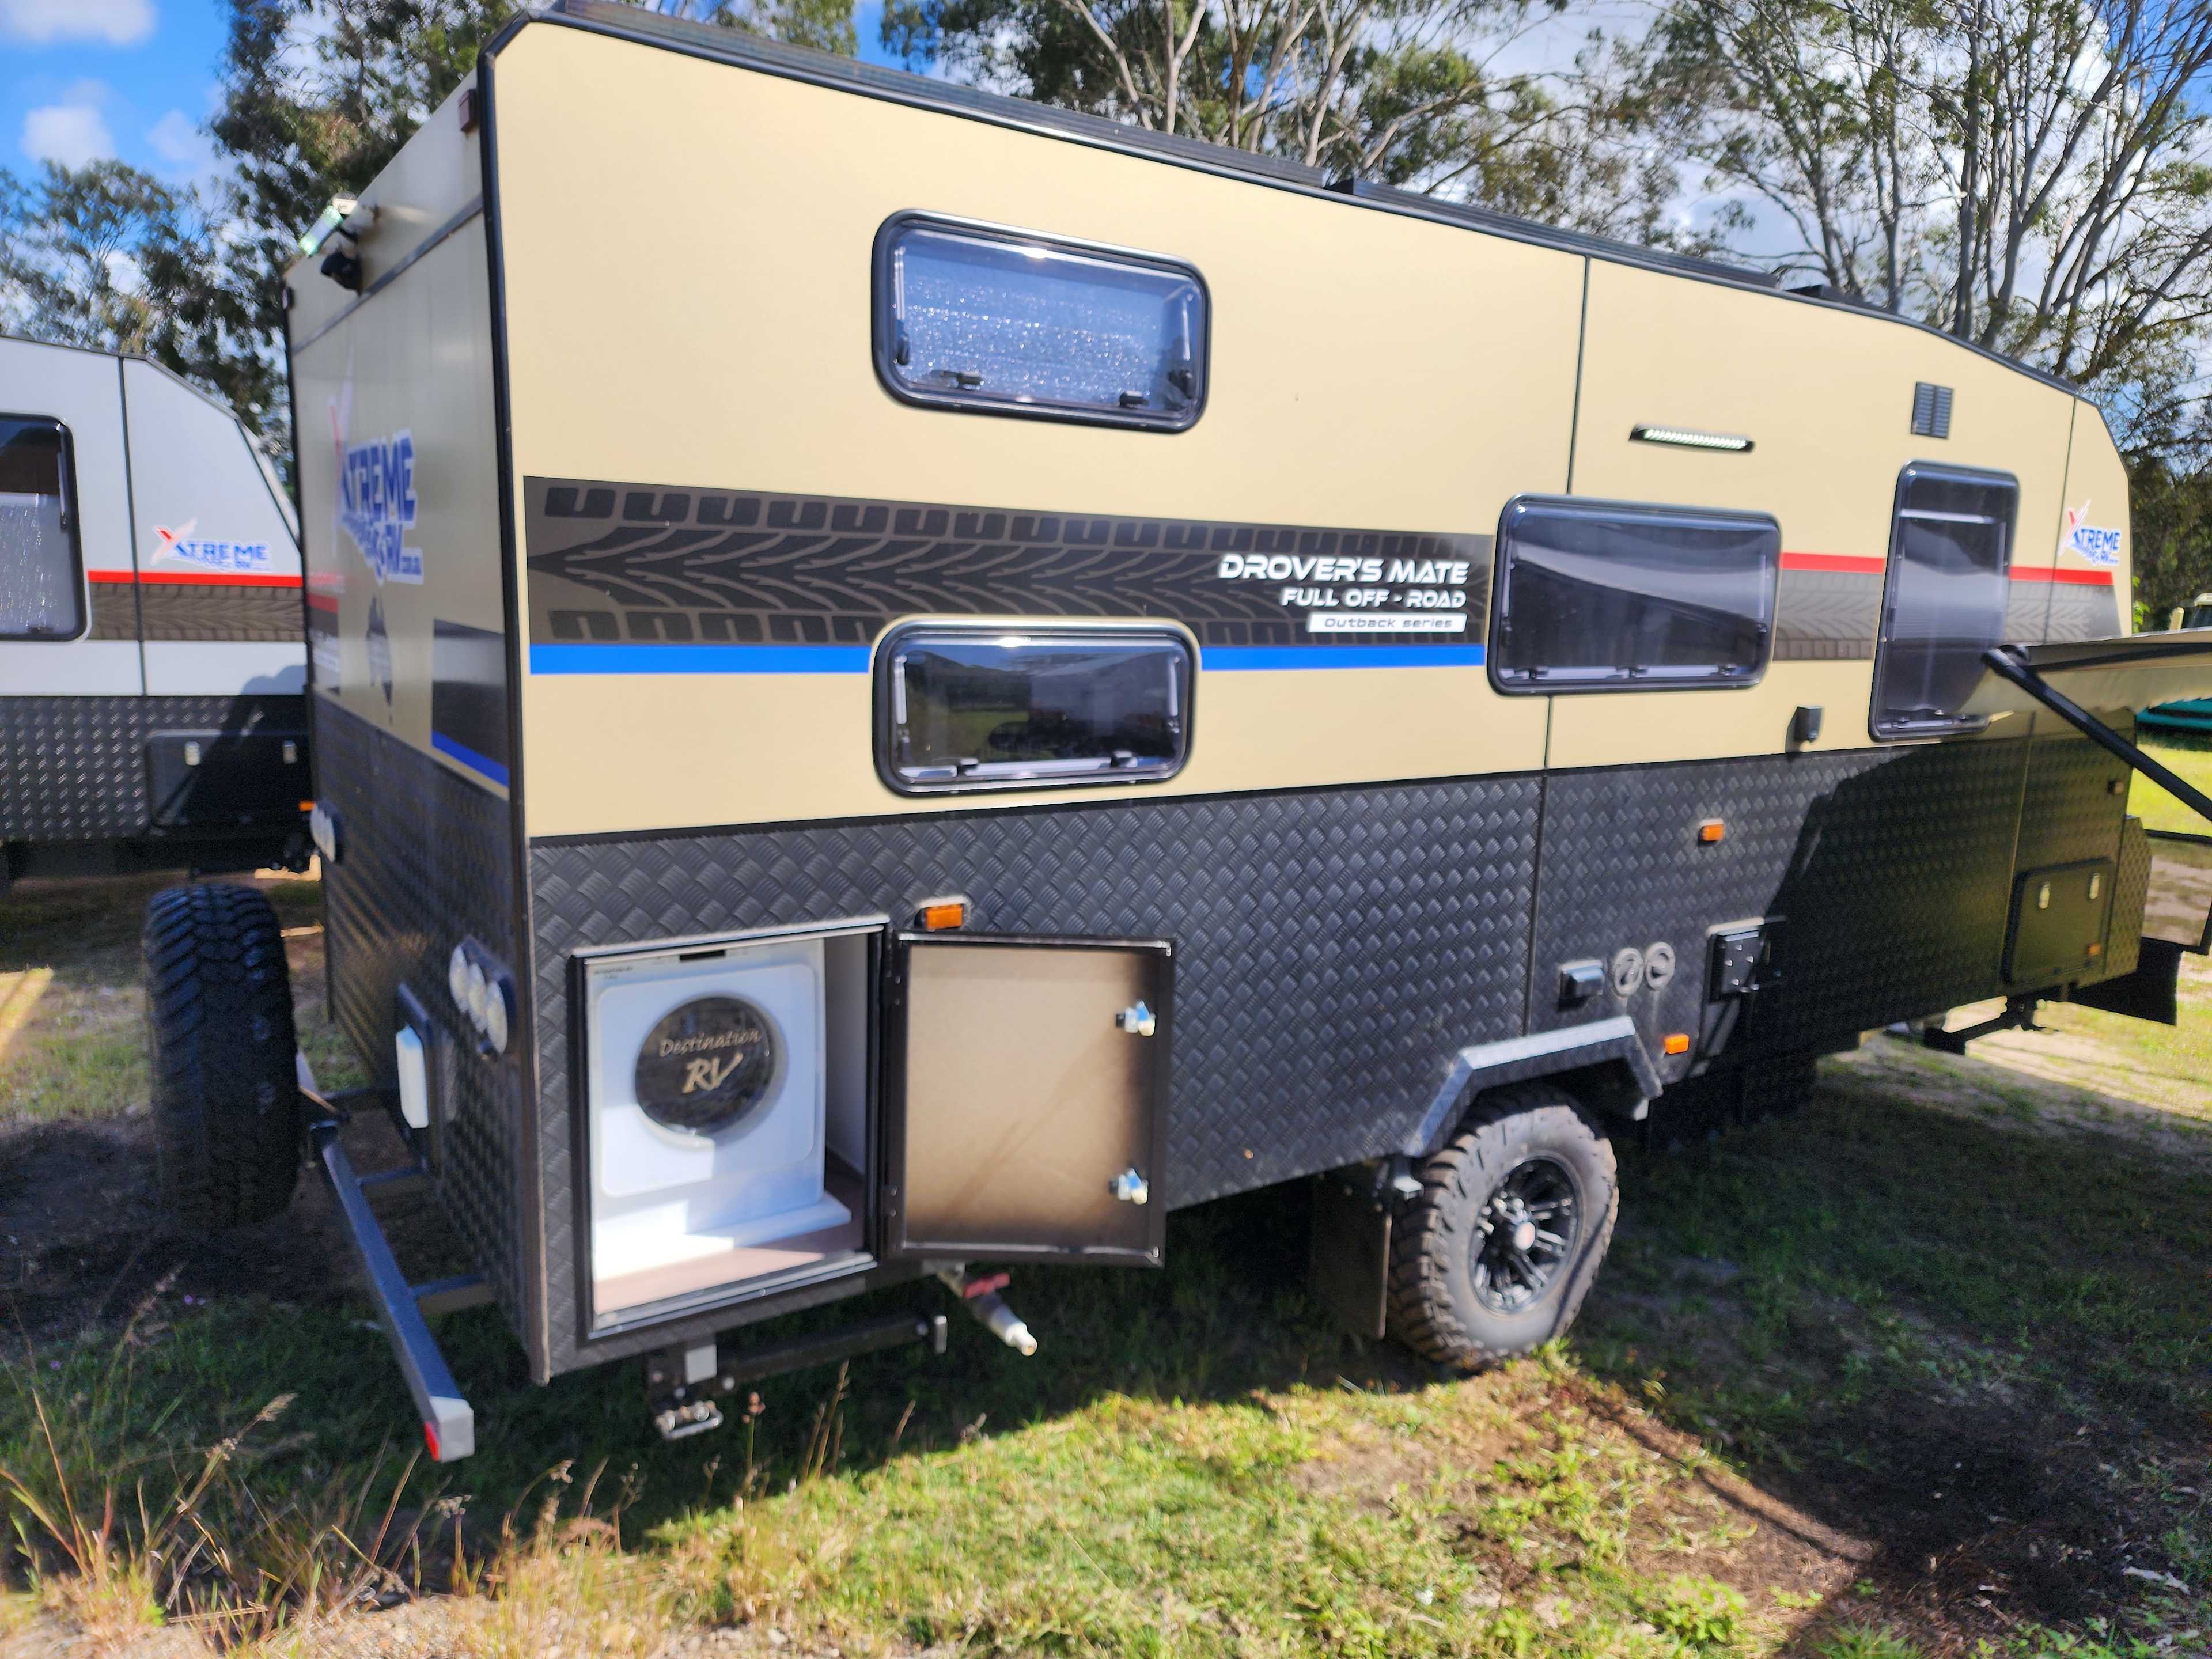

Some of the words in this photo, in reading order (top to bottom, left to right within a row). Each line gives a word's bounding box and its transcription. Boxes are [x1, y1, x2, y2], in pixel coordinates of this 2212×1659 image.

[151, 518, 267, 565] XTREME
[2057, 500, 2120, 554] XTREME
[1219, 554, 1384, 582] DROVER'S
[1387, 559, 1470, 584] MATE
[1281, 588, 1339, 607] FULL
[1345, 589, 1390, 607] OFF
[1406, 590, 1467, 608] ROAD
[1325, 618, 1395, 628] Outback
[1403, 619, 1452, 628] series
[659, 1028, 760, 1056] Destination
[682, 1051, 743, 1093] RV
